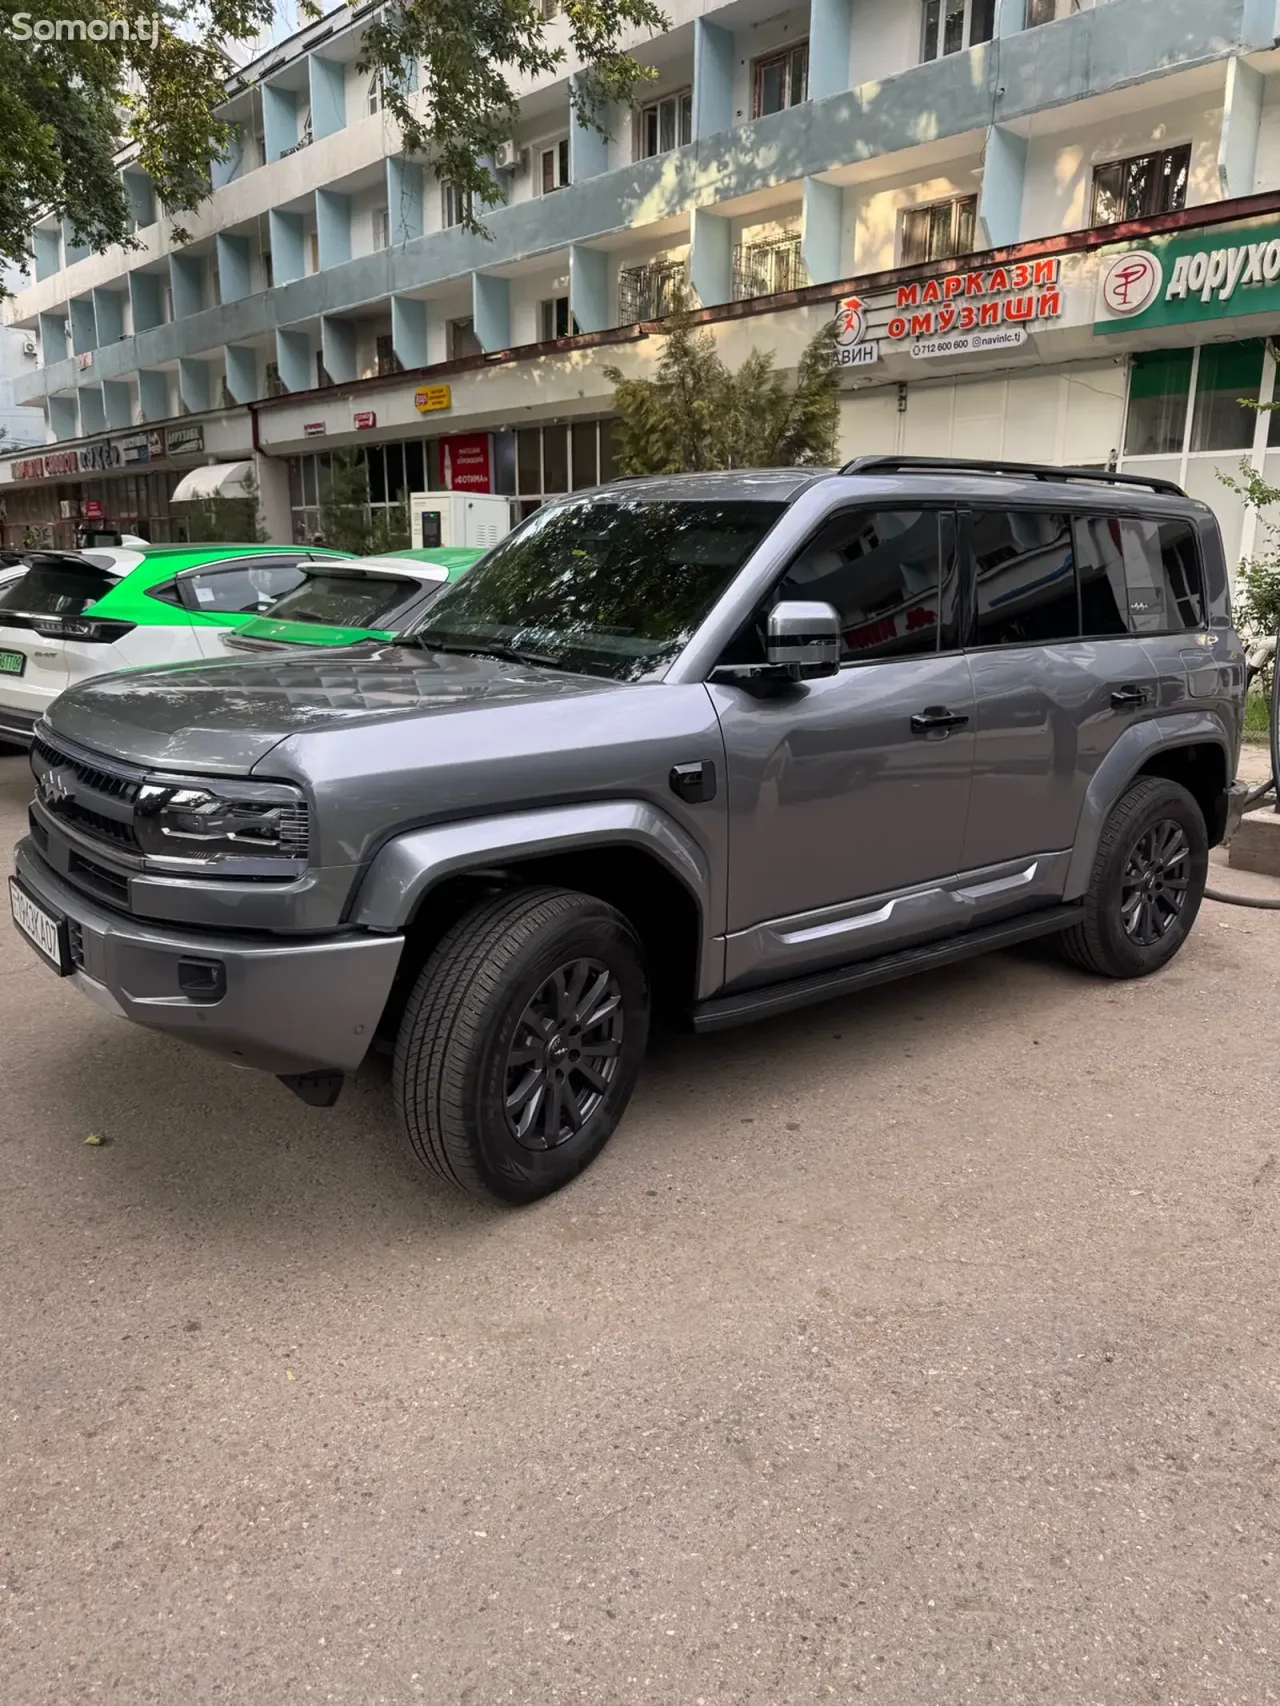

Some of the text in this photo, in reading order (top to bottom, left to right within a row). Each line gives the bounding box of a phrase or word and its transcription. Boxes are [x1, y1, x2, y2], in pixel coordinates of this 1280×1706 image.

[895, 257, 1059, 309] МАРКАЗИ
[830, 346, 873, 365] АВИН
[921, 343, 936, 354] 712
[937, 341, 951, 353] 600
[953, 339, 969, 350] 600
